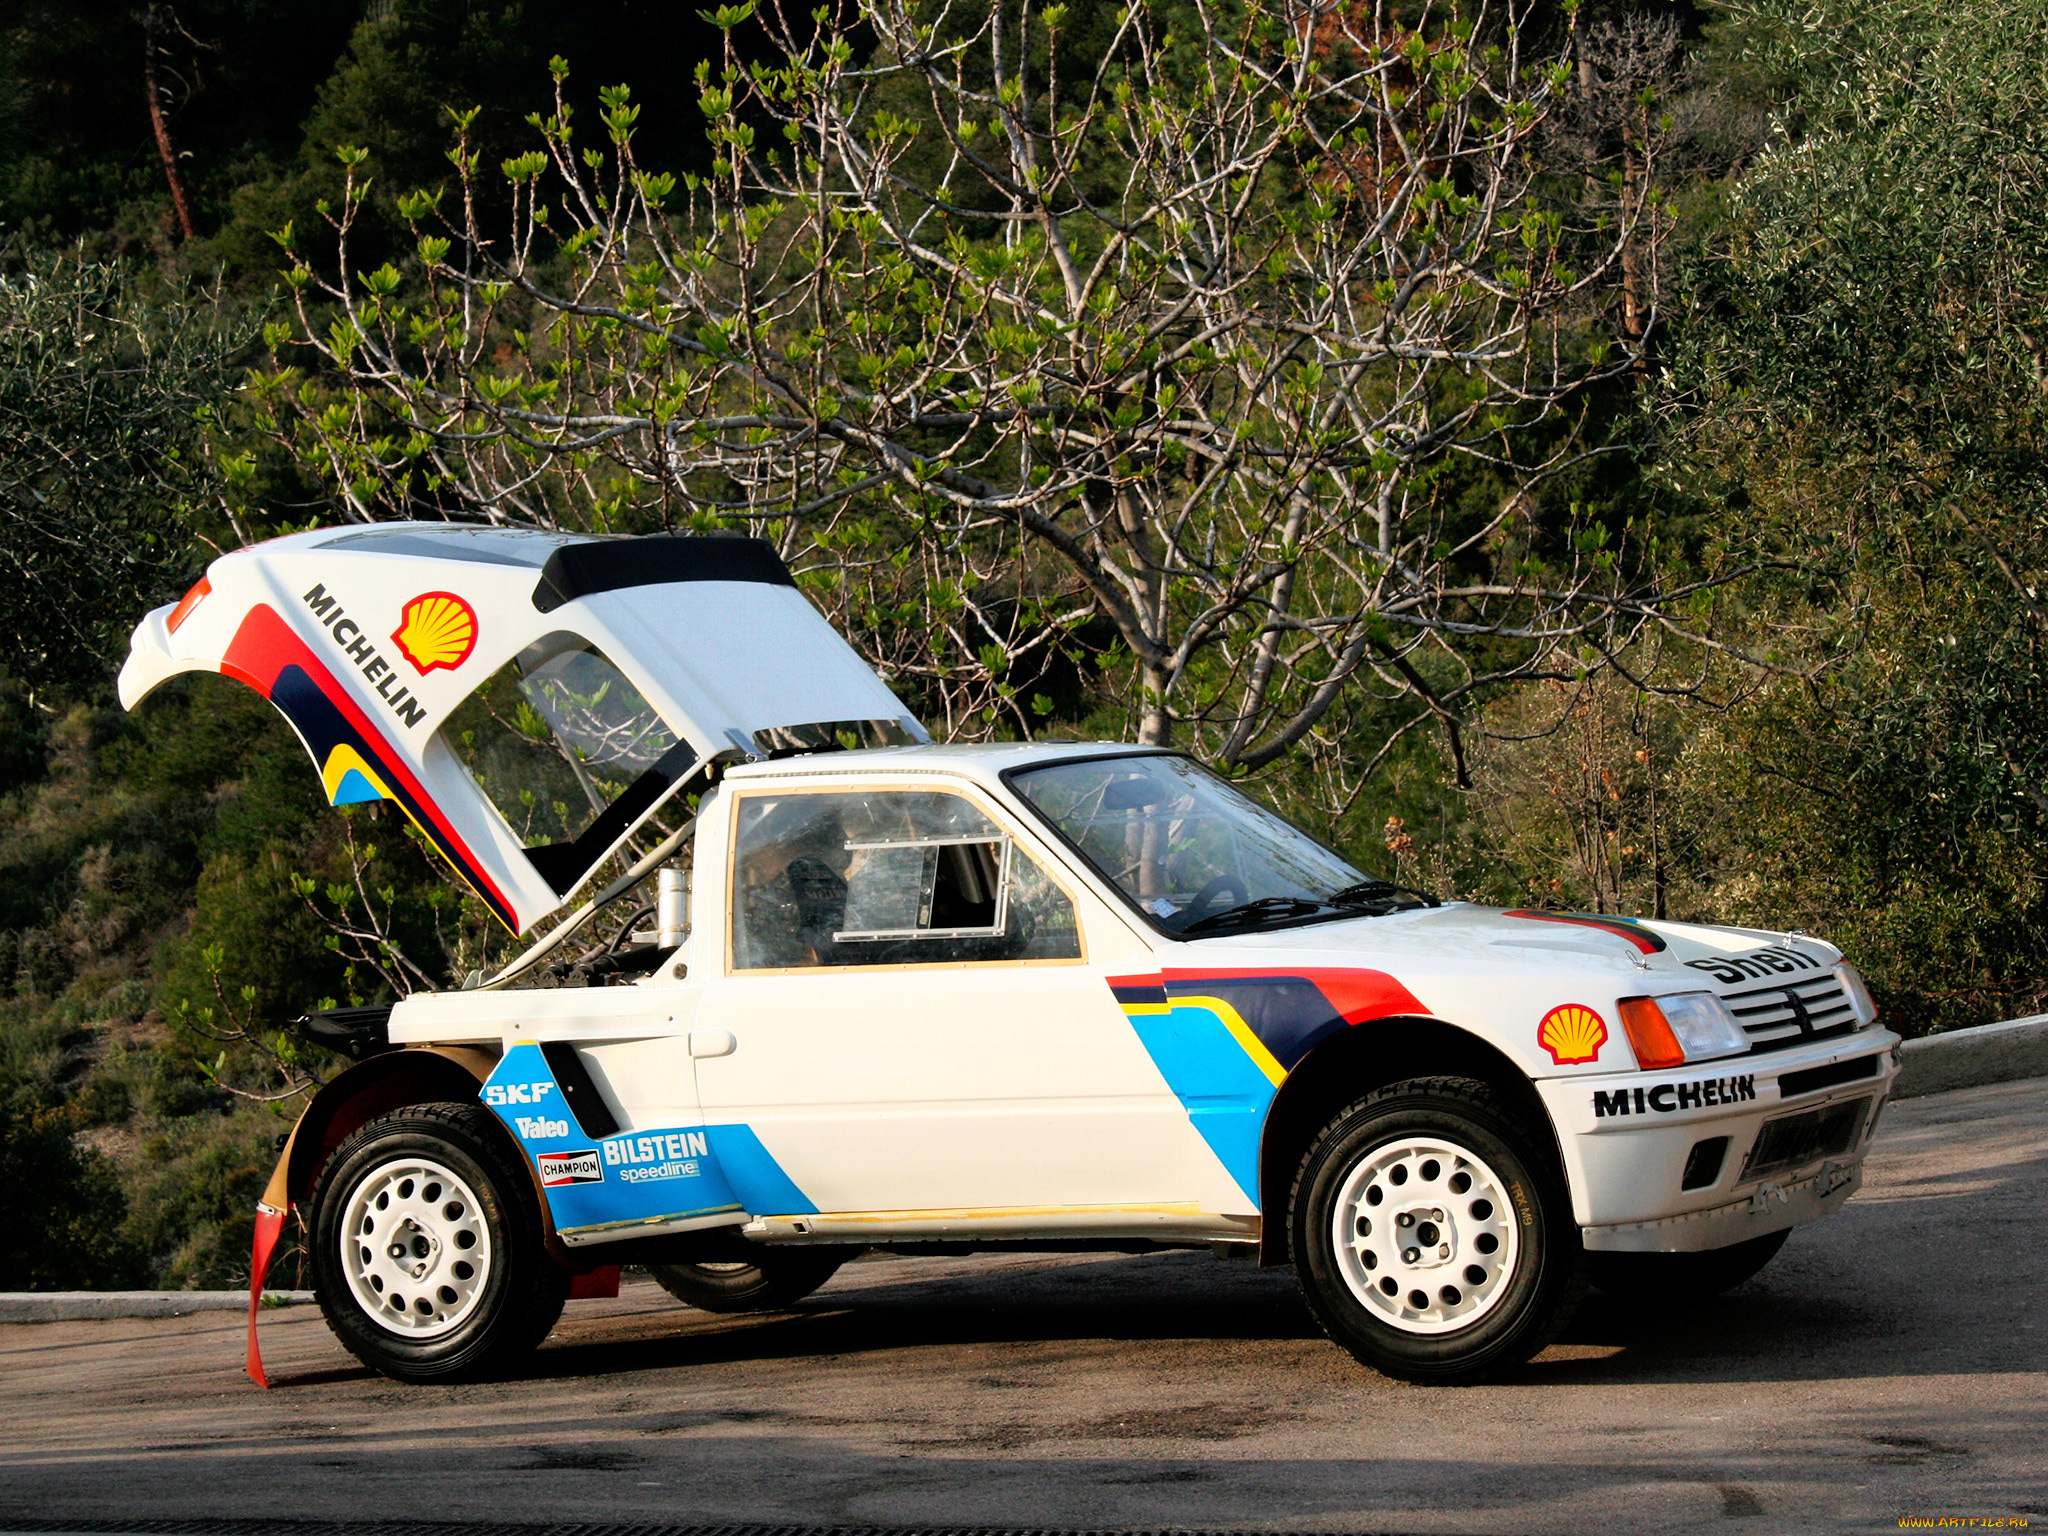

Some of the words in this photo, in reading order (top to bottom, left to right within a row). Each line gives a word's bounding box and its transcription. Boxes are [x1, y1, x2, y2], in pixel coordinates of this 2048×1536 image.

[303, 583, 427, 729] MICHELIN
[1683, 947, 1821, 984] Shell
[486, 1082, 555, 1106] SKF
[1594, 1074, 1756, 1117] MICHELIN
[515, 1116, 569, 1139] Valeo
[603, 1132, 708, 1166] BILSTEIN
[543, 1160, 598, 1176] CHAMPION
[620, 1160, 698, 1183] speedline
[1510, 1180, 1528, 1207] TRX
